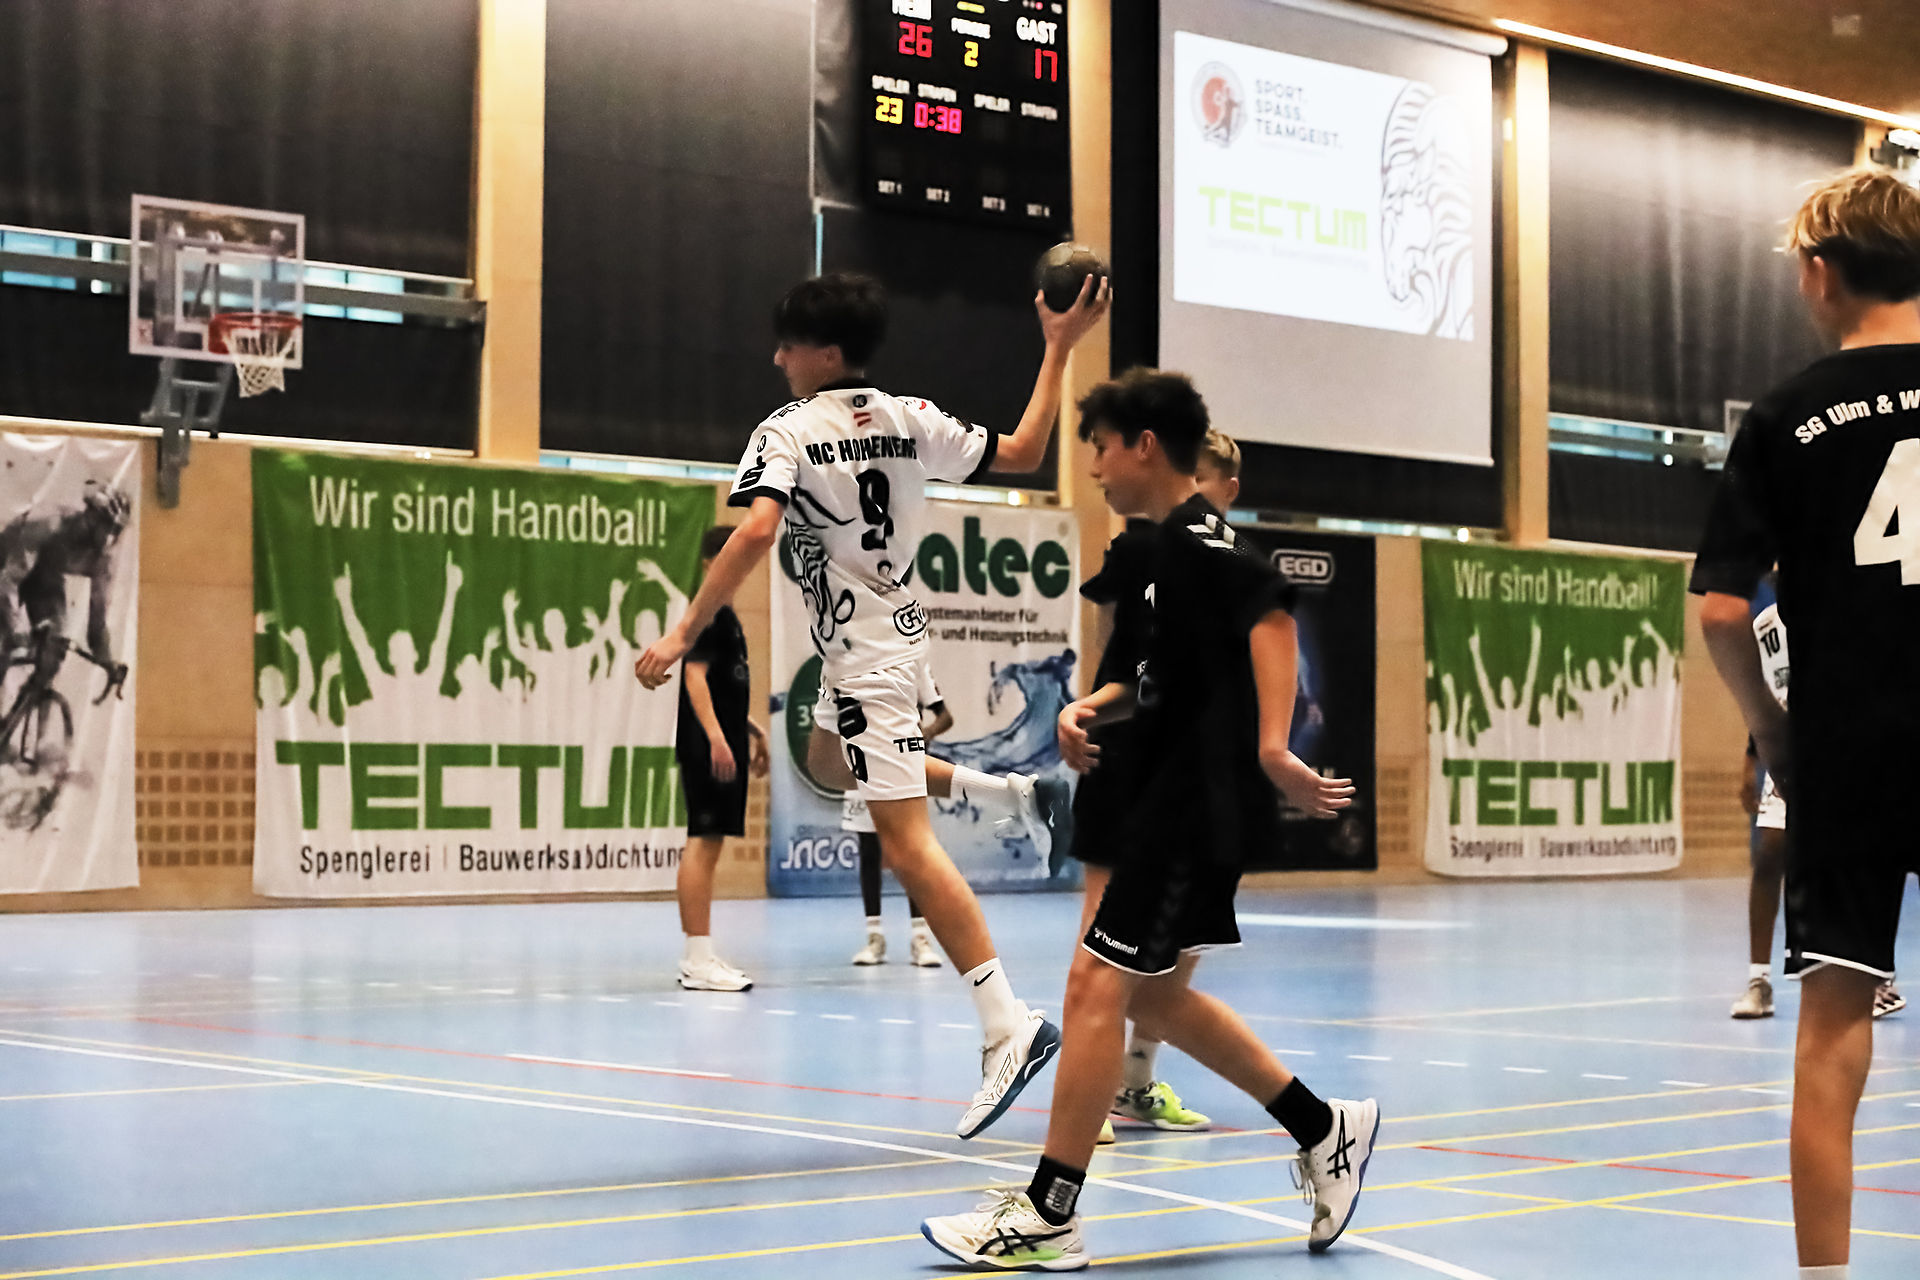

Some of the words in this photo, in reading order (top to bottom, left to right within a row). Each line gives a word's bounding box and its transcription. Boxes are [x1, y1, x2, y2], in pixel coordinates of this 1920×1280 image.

[898, 21, 933, 58] 26
[1016, 16, 1057, 44] GAST
[964, 41, 979, 67] 2
[1034, 48, 1058, 82] 17
[875, 95, 903, 124] 23
[914, 102, 962, 134] 0:38
[1196, 184, 1369, 252] TECTUM
[1794, 415, 1828, 444] SG
[1826, 400, 1872, 426] Ulm
[1876, 394, 1894, 414] &
[805, 441, 836, 466] HC
[309, 474, 378, 530] Wir
[391, 483, 475, 536] sind
[491, 488, 667, 548] Handball!
[857, 468, 895, 551] 9
[1852, 437, 1920, 586] 4
[1279, 556, 1328, 578] EGD
[1453, 558, 1493, 600] Wir
[1499, 563, 1549, 605] sind
[1556, 567, 1658, 611] Handball!
[925, 606, 1016, 624] ystemanbieter
[1018, 608, 1039, 623] für
[941, 626, 967, 641] und
[1760, 626, 1781, 659] 10
[275, 740, 688, 831] TECTUM
[1441, 757, 1676, 827] TECTUM
[299, 844, 431, 878] Spenglerei
[1102, 932, 1138, 955] hummel
